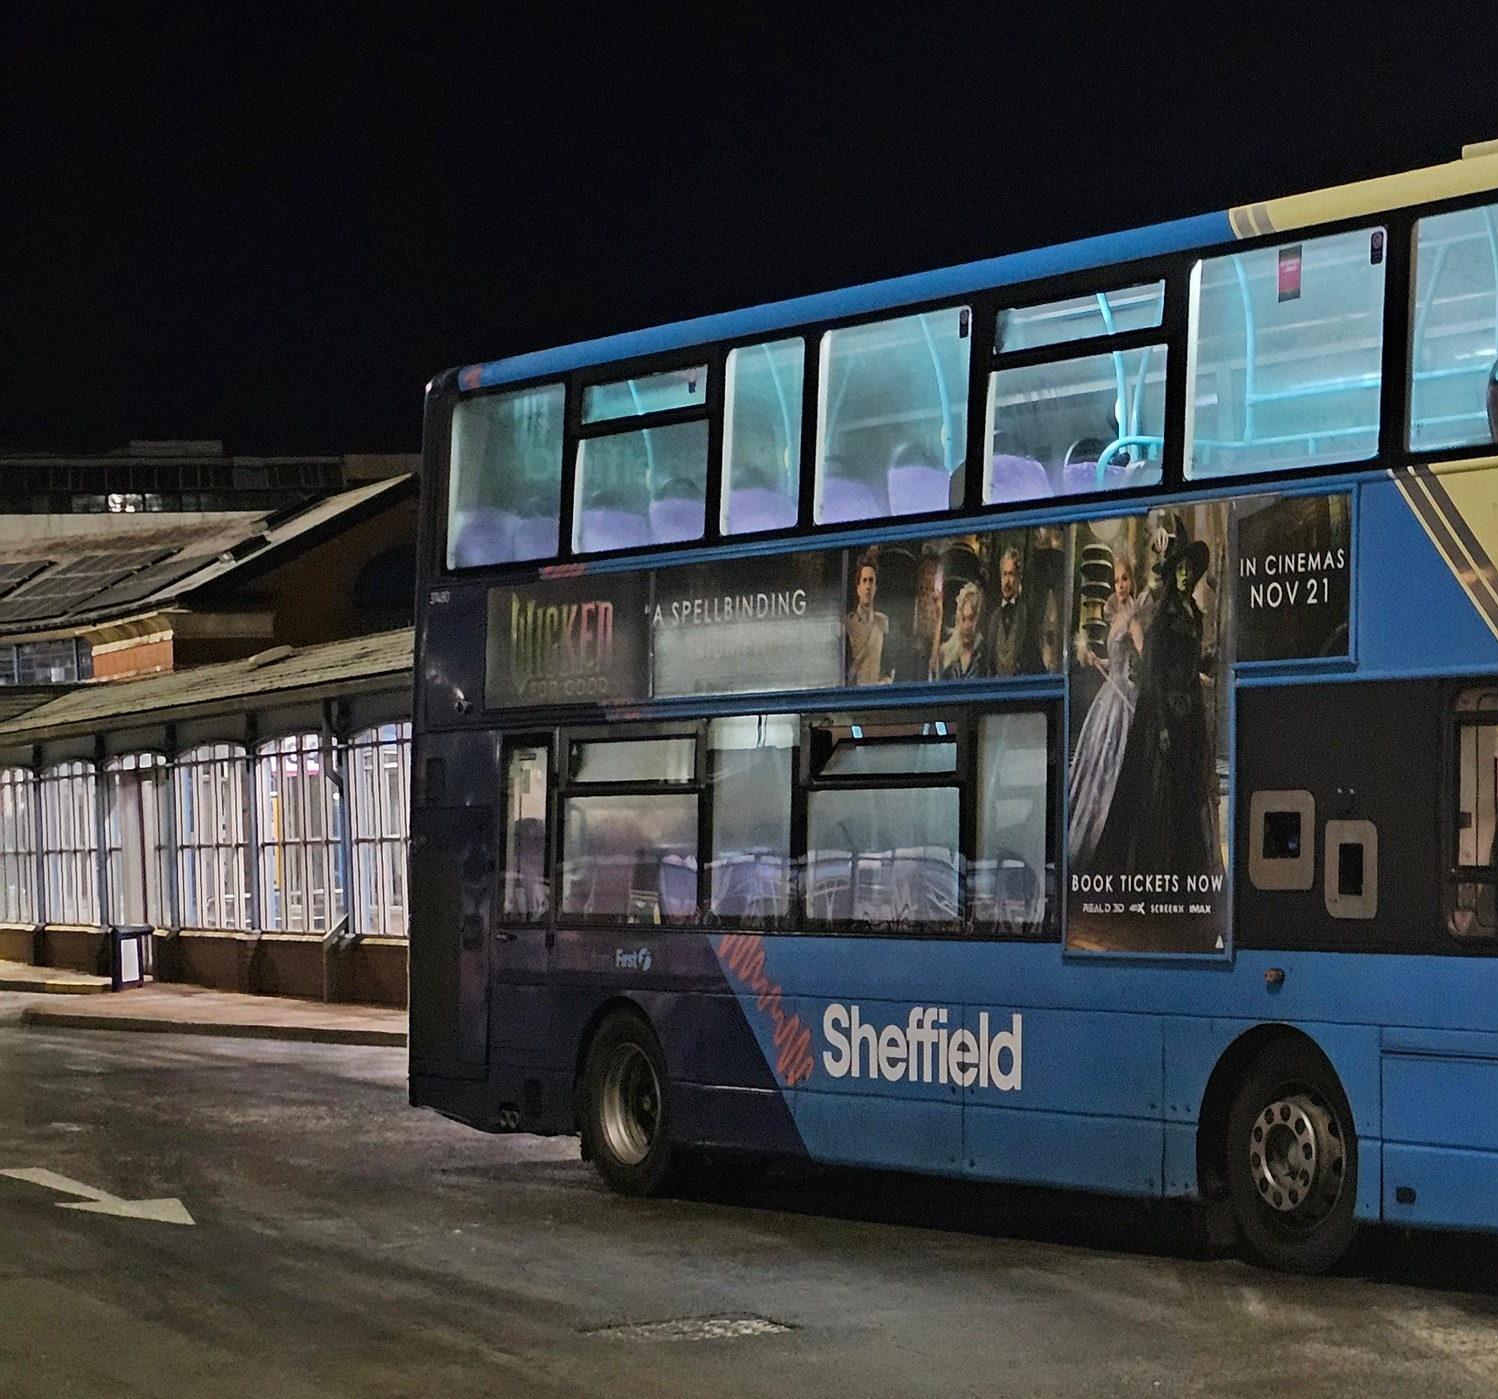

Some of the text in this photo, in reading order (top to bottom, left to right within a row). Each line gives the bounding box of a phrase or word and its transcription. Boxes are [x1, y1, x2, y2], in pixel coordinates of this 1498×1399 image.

[1240, 548, 1345, 578] IN CINEMAS
[671, 588, 807, 626] SPELLBINDING
[1250, 577, 1329, 609] NOV 21
[1071, 874, 1224, 893] BOOK TICKETS NOW
[1188, 903, 1212, 915] IMAX
[822, 1003, 1023, 1091] Sheffield
